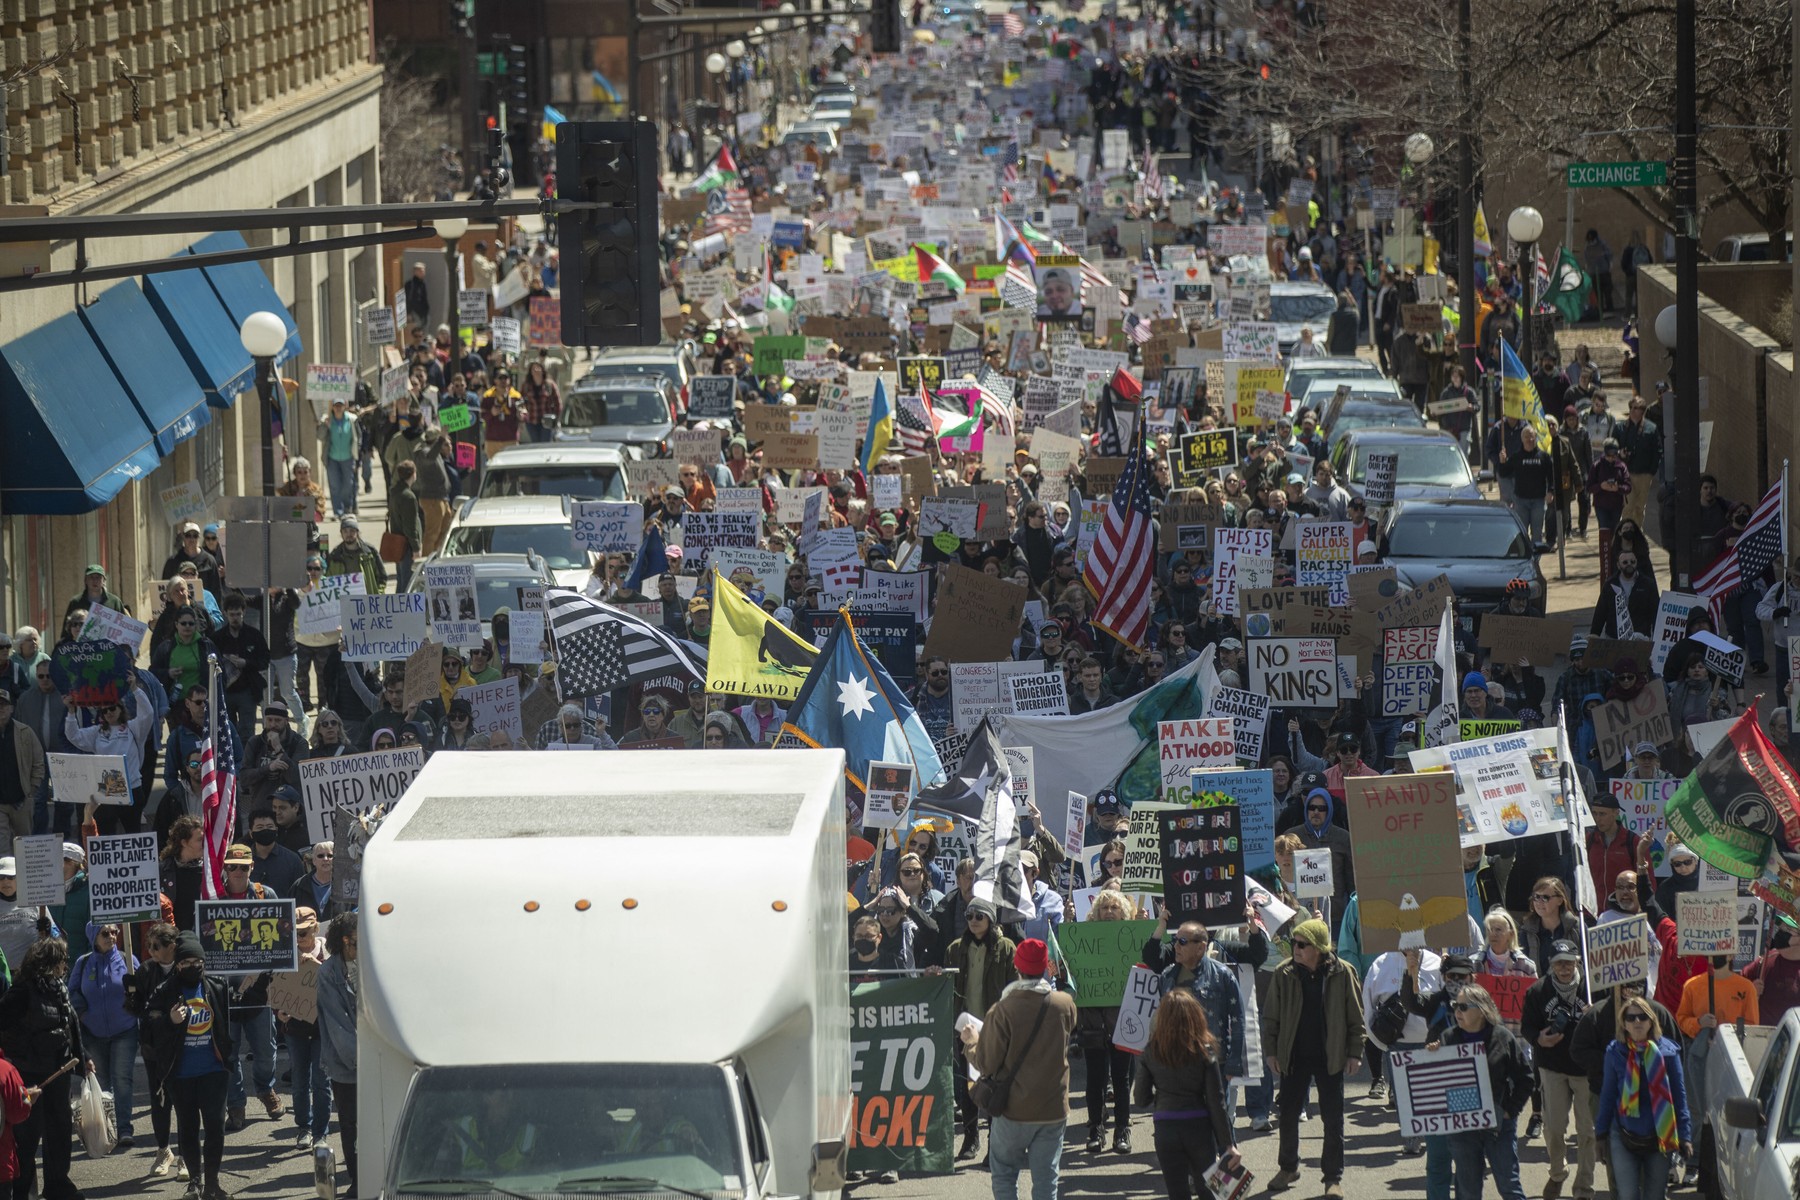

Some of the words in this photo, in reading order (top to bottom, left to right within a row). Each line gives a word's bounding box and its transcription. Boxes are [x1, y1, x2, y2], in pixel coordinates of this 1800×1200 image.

[1570, 166, 1640, 183] EXCHANGE
[1647, 164, 1654, 172] ST
[1036, 256, 1051, 265] FREE
[1180, 285, 1208, 293] VOTE
[1239, 332, 1259, 345] YOUR
[1253, 335, 1275, 350] LAND
[308, 365, 354, 375] PROTECT
[1242, 370, 1282, 379] PROTECT
[318, 374, 347, 383] NOAA
[1029, 376, 1061, 387] DEFEND
[1087, 373, 1100, 381] NO
[307, 382, 351, 393] SCIENCE
[696, 381, 728, 391] DEFEND
[820, 385, 849, 400] STOP
[693, 397, 728, 408] PLANET
[447, 413, 462, 421] OUR
[822, 415, 853, 424] HANDS
[675, 431, 715, 440] DEMOCRACY
[1194, 433, 1221, 441] STOP
[1376, 472, 1392, 480] NOT
[718, 490, 746, 498] HANDS
[747, 490, 761, 498] OFF
[581, 505, 619, 517] Lesson
[621, 506, 630, 517] 1
[688, 515, 701, 523] DO
[706, 515, 718, 523] WE
[723, 515, 752, 523] REALLY
[575, 520, 595, 531] DO
[601, 521, 626, 531] NOT
[685, 525, 706, 534] NEED
[710, 525, 718, 533] TO
[722, 525, 738, 533] TELL
[742, 525, 755, 534] YOU
[575, 532, 606, 542] OBEY
[613, 533, 627, 542] IN
[1303, 526, 1345, 538] SUPER
[684, 534, 755, 548] CONCENTRATION
[1218, 529, 1252, 545] THIS
[1255, 530, 1271, 548] IS
[1301, 537, 1349, 549] CALLOUS
[587, 542, 637, 552] ADVANCE
[720, 550, 733, 558] The
[1299, 548, 1351, 560] FRAGILE
[684, 559, 706, 569] ARE
[1300, 560, 1351, 571] RACIST
[427, 565, 472, 576] REMEMBER
[429, 576, 471, 586] DEMOCRACY?
[878, 578, 891, 588] Be
[895, 579, 915, 589] Like
[821, 592, 844, 604] The
[846, 589, 887, 600] Climate
[968, 591, 984, 600] OUR
[350, 598, 365, 616] TO
[369, 596, 380, 614] BE
[386, 594, 423, 613] CLEAR
[635, 602, 661, 615] THE
[350, 618, 365, 631] WE
[371, 615, 393, 630] ARE
[1311, 623, 1350, 635] HANDS
[107, 626, 123, 640] UP
[448, 634, 467, 643] GREAT
[59, 643, 95, 655] UN-FUCK
[98, 642, 114, 651] THE
[1256, 644, 1286, 669] NO
[1299, 641, 1314, 649] NOT
[1315, 638, 1333, 648] NOW
[1299, 649, 1314, 658] NOT
[1316, 648, 1335, 658] EVER
[72, 654, 103, 663] WORLD
[1707, 650, 1742, 676] BACK!
[955, 667, 996, 676] CONGRESS:
[643, 675, 684, 694] HARVARD
[1012, 674, 1060, 688] UPHOLD
[1264, 669, 1332, 704] KINGS
[712, 679, 738, 691] OH
[741, 682, 789, 698] LAWD
[1014, 684, 1062, 700] INDIGENOUS
[1016, 696, 1065, 712] SOVEREIGNTY!
[1384, 700, 1408, 713] OF
[1161, 719, 1230, 740] MAKE
[1461, 723, 1471, 736] IS
[1475, 723, 1520, 736] NOTHING
[1161, 741, 1234, 760] ATWOOD
[1449, 744, 1490, 761] CLIMATE
[1494, 738, 1527, 753] CRISIS
[51, 757, 65, 766] Stop
[302, 763, 328, 779] DEAR
[331, 755, 388, 776] DEMOCRATIC
[392, 751, 422, 766] PARTY,
[1489, 763, 1515, 772] DUMPSTER
[1195, 776, 1215, 788] The
[1218, 777, 1242, 786] World
[1492, 772, 1506, 780] DON'T
[1232, 786, 1263, 796] Enough
[1362, 781, 1448, 809] HANDS
[1482, 787, 1503, 800] FIRE
[1504, 782, 1526, 795] HIM!
[1530, 800, 1540, 808] 86
[1635, 804, 1657, 813] OUR
[1385, 812, 1424, 832] OFF
[90, 837, 154, 851] DEFEND
[90, 851, 111, 865] OUR
[114, 849, 155, 863] PLANET,
[1306, 859, 1318, 870] No
[108, 866, 140, 878] NOT
[1300, 873, 1326, 885] Kings!
[92, 879, 156, 896] CORPORATE
[93, 894, 158, 911] PROFITS!
[207, 907, 249, 920] HANDS
[252, 906, 282, 919] OFF!!
[1590, 919, 1644, 949] PROTECT
[1683, 929, 1731, 939] CLIMATE
[1683, 940, 1716, 950] ACTION
[1717, 937, 1735, 950] NOW!
[1590, 940, 1646, 969] NATIONAL
[1602, 960, 1641, 985] PARKS
[1495, 978, 1521, 991] NO
[859, 1007, 877, 1028] IS
[881, 1003, 935, 1027] HERE.
[1392, 1051, 1415, 1067] U.S.
[1457, 1044, 1469, 1057] IS
[1472, 1042, 1486, 1054] IN
[880, 1037, 935, 1091] TO
[1411, 1110, 1492, 1133] DISTRESS
